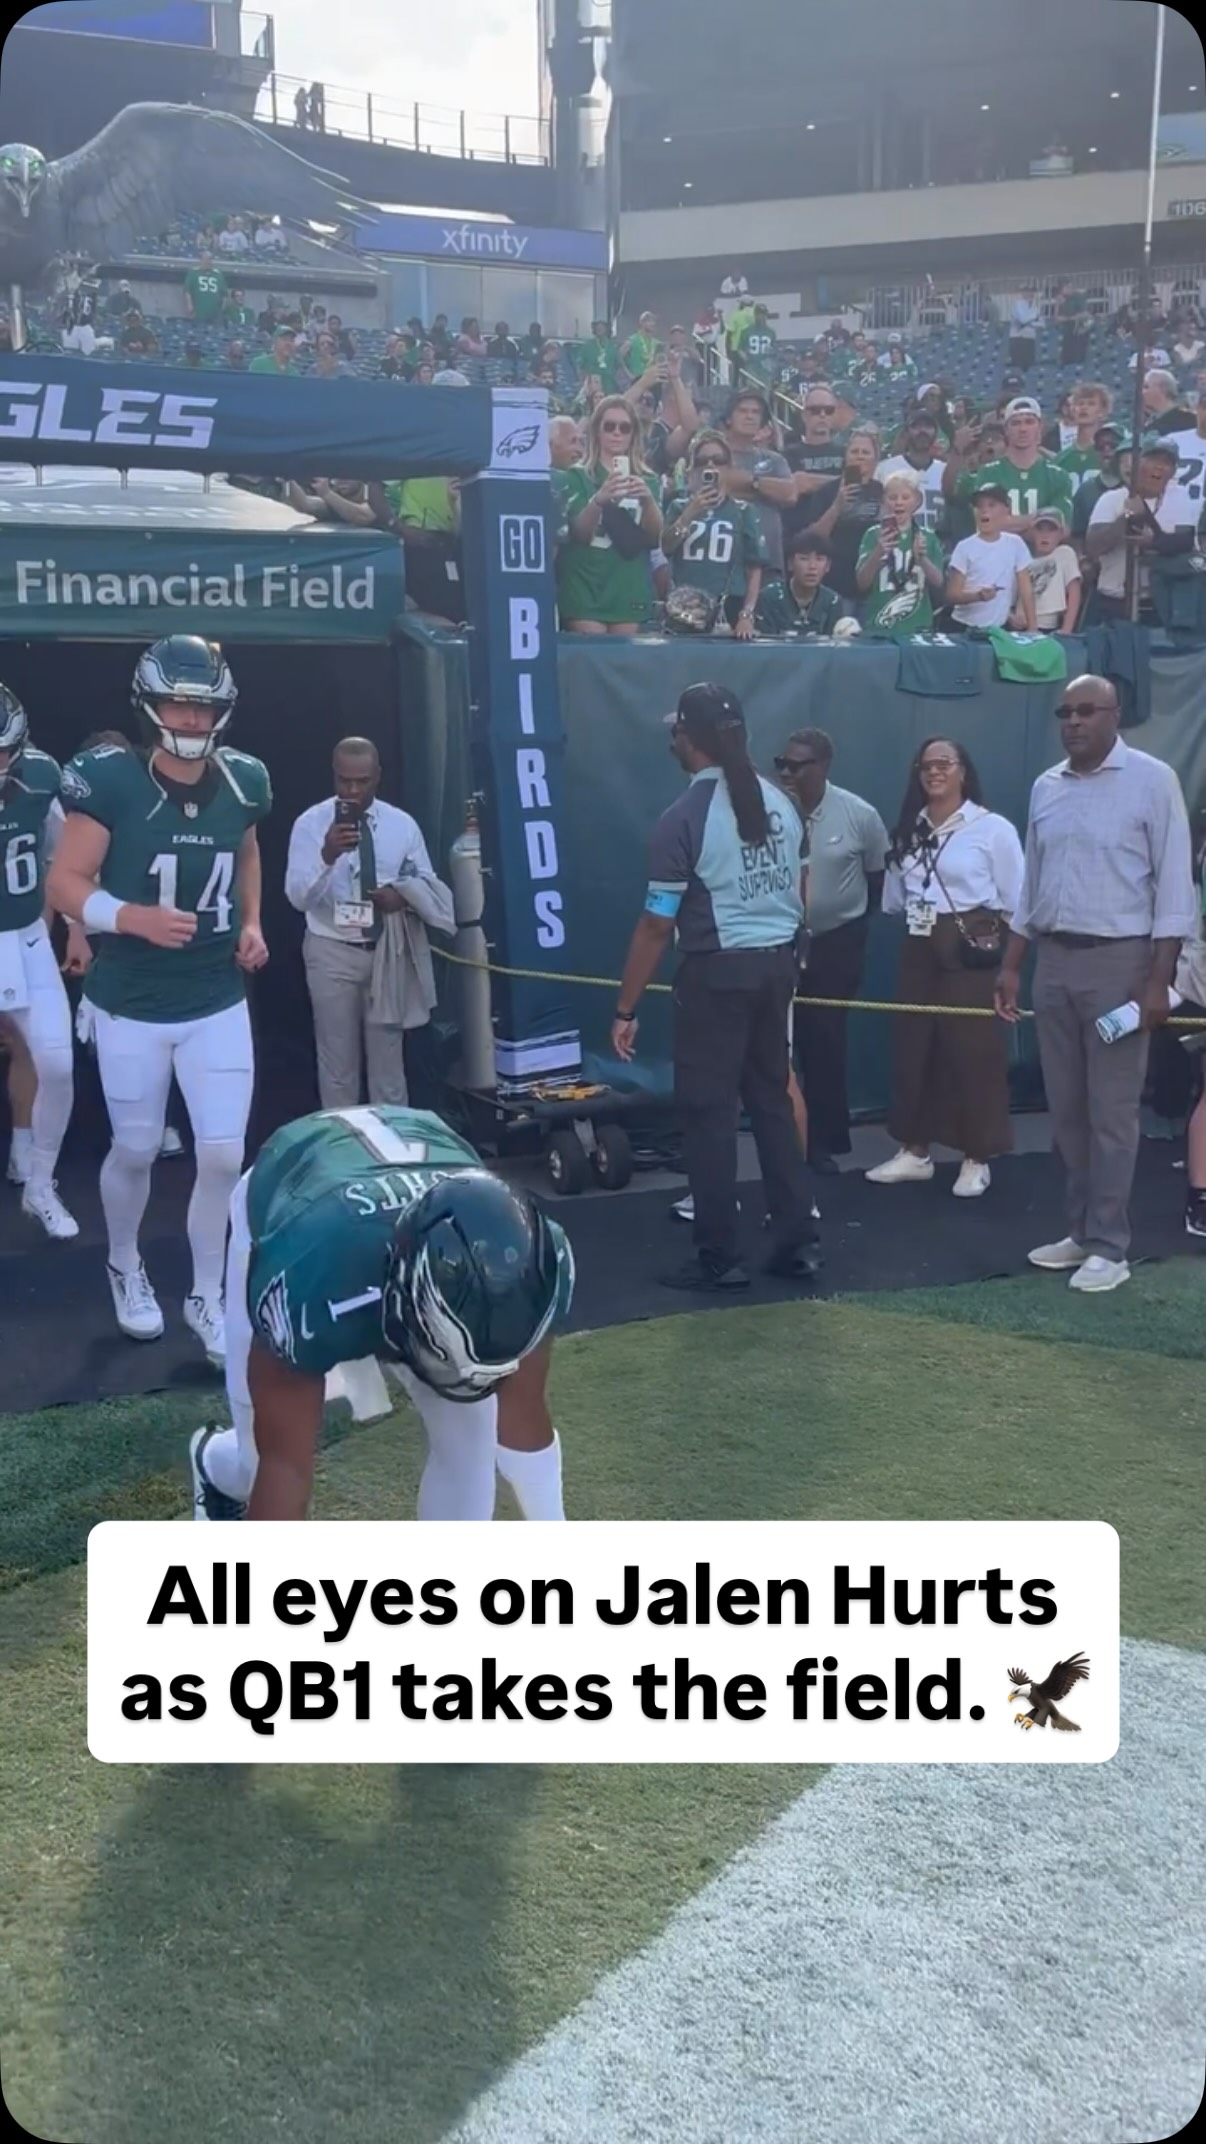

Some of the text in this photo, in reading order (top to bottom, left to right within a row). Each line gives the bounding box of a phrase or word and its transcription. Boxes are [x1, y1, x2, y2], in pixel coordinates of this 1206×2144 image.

[442, 224, 528, 258] xfinity
[198, 276, 219, 293] 55
[749, 335, 771, 355] 92
[1007, 488, 1038, 516] 11
[502, 518, 542, 570] GO
[683, 520, 734, 563] 26
[16, 559, 375, 610] Financial Field
[509, 597, 566, 949] BIRDS
[172, 834, 214, 845] EAGLES
[148, 851, 234, 933] 14
